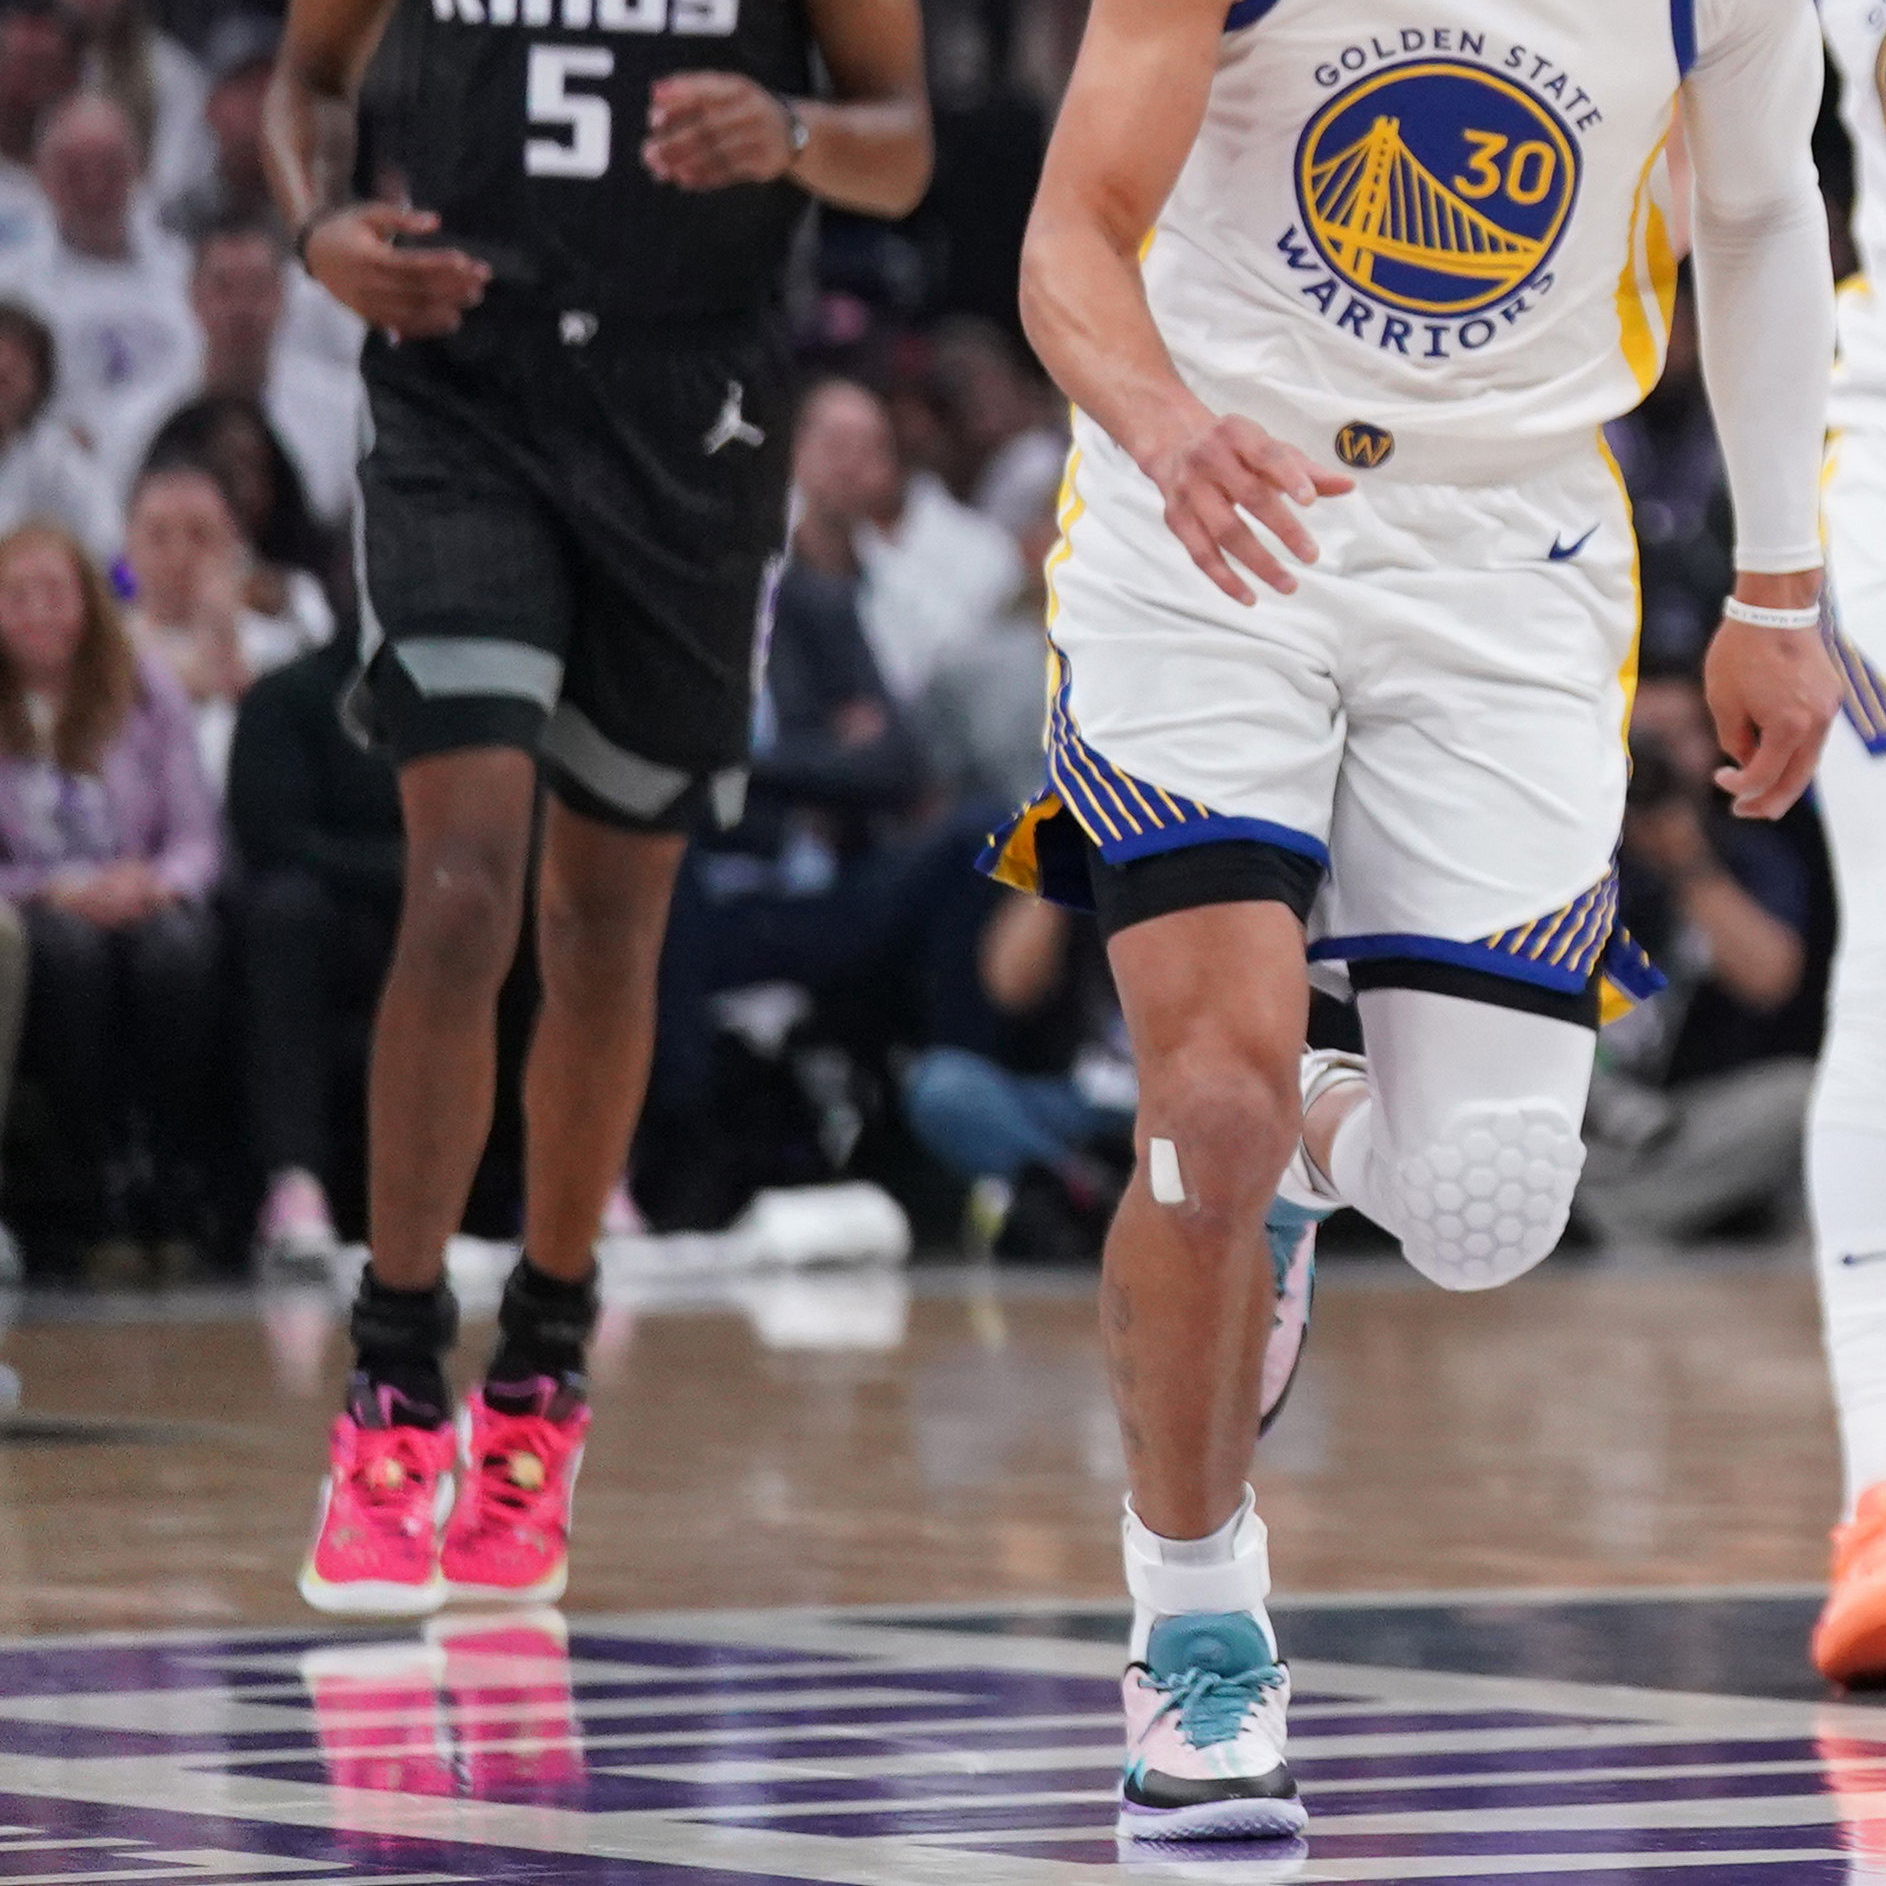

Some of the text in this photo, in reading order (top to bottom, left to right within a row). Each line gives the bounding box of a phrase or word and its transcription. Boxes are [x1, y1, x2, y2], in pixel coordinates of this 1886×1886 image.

[524, 44, 614, 179] 5
[1314, 28, 1604, 134] GOLDEN STATE
[1454, 129, 1556, 205] 30
[1276, 224, 1555, 359] WARRIORS
